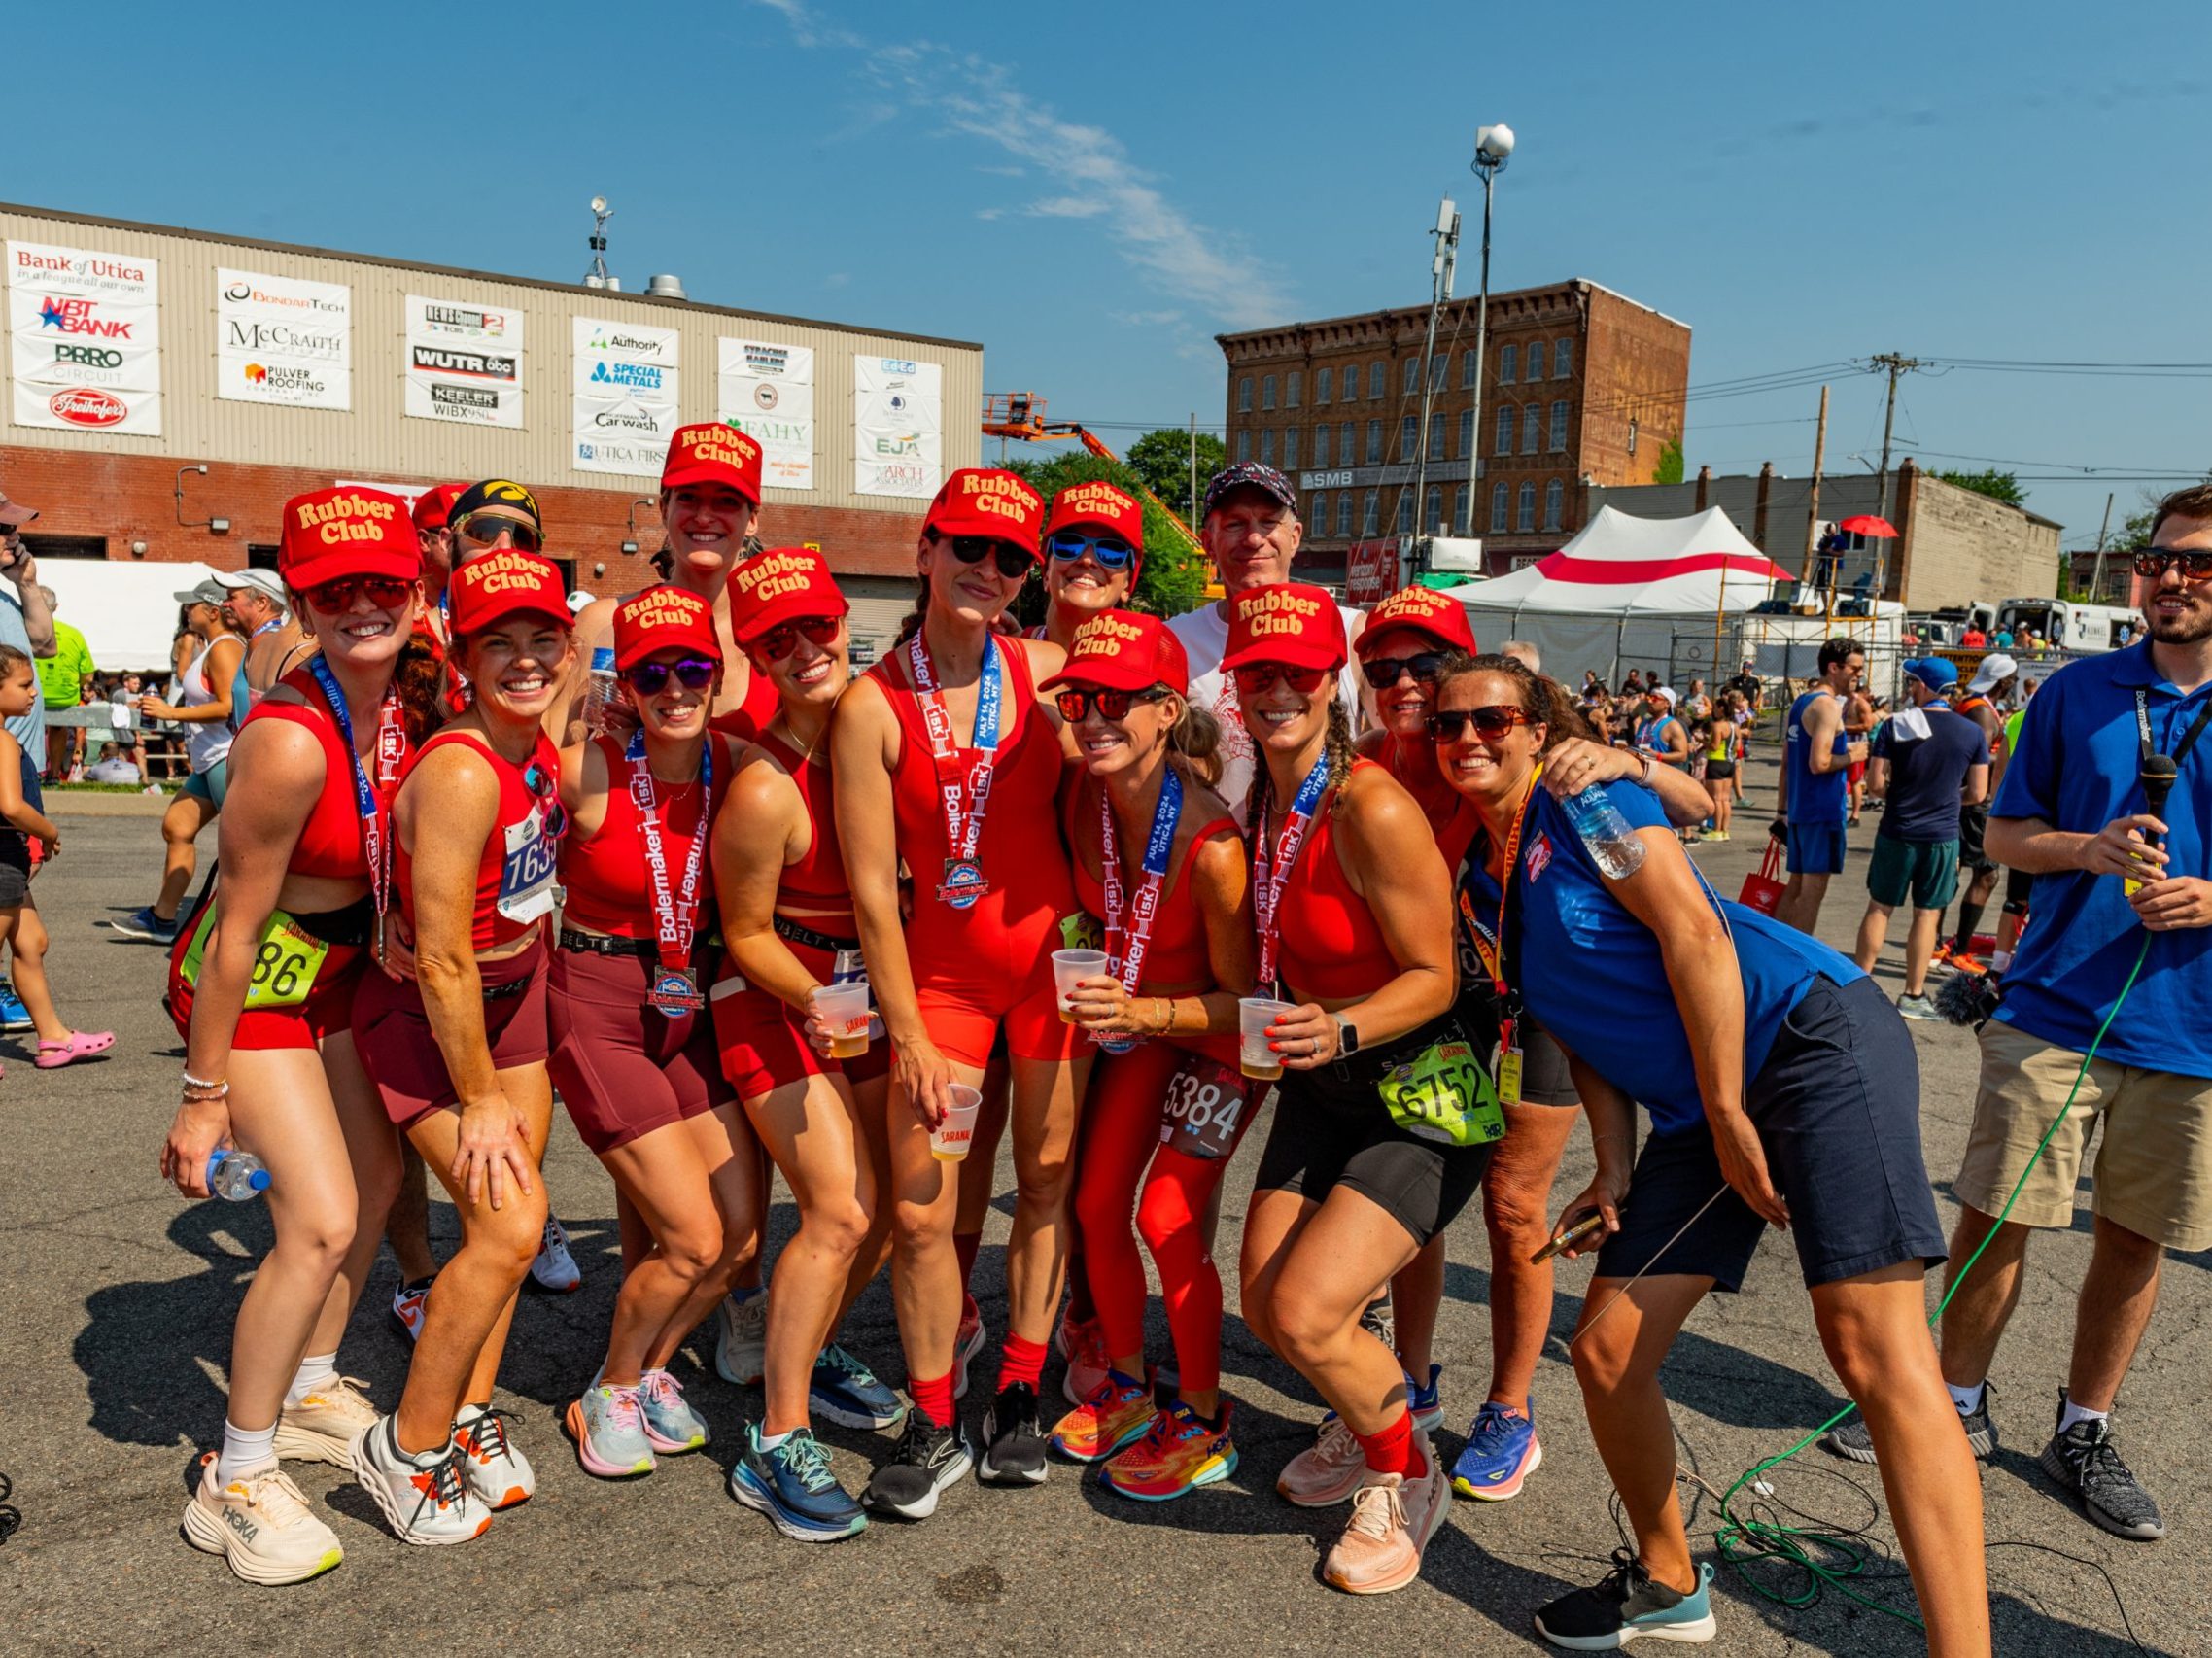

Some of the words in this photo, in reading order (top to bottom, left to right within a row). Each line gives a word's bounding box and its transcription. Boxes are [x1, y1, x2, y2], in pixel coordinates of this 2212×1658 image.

[17, 251, 71, 271] Bank
[74, 260, 88, 275] of
[92, 260, 144, 281] Utica
[17, 269, 30, 279] in
[42, 270, 82, 285] league
[84, 275, 97, 286] all
[100, 280, 118, 289] our
[121, 284, 144, 293] own
[41, 296, 98, 318] NBT
[59, 317, 133, 339] BANK
[484, 314, 504, 330] 2
[55, 344, 122, 368] PRRO
[611, 335, 662, 356] Authority
[268, 366, 310, 379] PULVER
[415, 349, 484, 371] WUTR
[486, 360, 511, 373] abc
[613, 363, 662, 378] SPECIAL
[53, 367, 123, 383] CIRCUIT
[268, 378, 325, 392] ROOFING
[613, 375, 661, 389] METALS
[435, 389, 494, 404] KEELER
[745, 421, 806, 441] FAHY
[595, 446, 632, 460] UTICA
[638, 450, 667, 464] FIRS
[681, 426, 756, 461] Rubber
[877, 438, 920, 457] EJA
[695, 443, 743, 470] Club
[962, 474, 1039, 512] Rubber
[1063, 484, 1132, 511] Rubber
[296, 493, 395, 530] Rubber
[976, 494, 1026, 524] Club
[1074, 500, 1121, 519] Club
[321, 519, 383, 544] Club
[464, 552, 551, 586] Rubber
[736, 553, 815, 594] Rubber
[483, 572, 542, 594] Club
[757, 572, 811, 601] Club
[623, 588, 703, 623] Rubber
[1238, 589, 1321, 622] Rubber
[1375, 585, 1451, 613] Rubber
[1383, 601, 1434, 619] Club
[639, 609, 693, 630] Club
[1073, 614, 1143, 644] Rubber
[1250, 614, 1304, 637] Club
[1073, 637, 1121, 657] Club
[983, 675, 991, 700] 2024
[991, 684, 999, 698] NY
[981, 701, 990, 714] 14,
[928, 711, 945, 736] 15K
[979, 715, 988, 738] JULY
[384, 731, 397, 757] 15K
[638, 778, 650, 804] 15K
[977, 769, 989, 794] 15K
[1299, 779, 1313, 802] JULY
[1167, 805, 1176, 819] NY
[1148, 837, 1158, 860] JULY
[1158, 795, 1170, 820] 2024
[1284, 835, 1298, 858] 15K
[645, 825, 678, 944] Boilermaker
[1108, 884, 1117, 908] 15K
[1141, 891, 1154, 915] 15K
[1258, 886, 1268, 910] 15K
[1397, 1062, 1488, 1119] 6752
[1164, 1072, 1243, 1141] 5384
[222, 1504, 259, 1543] HOKA
